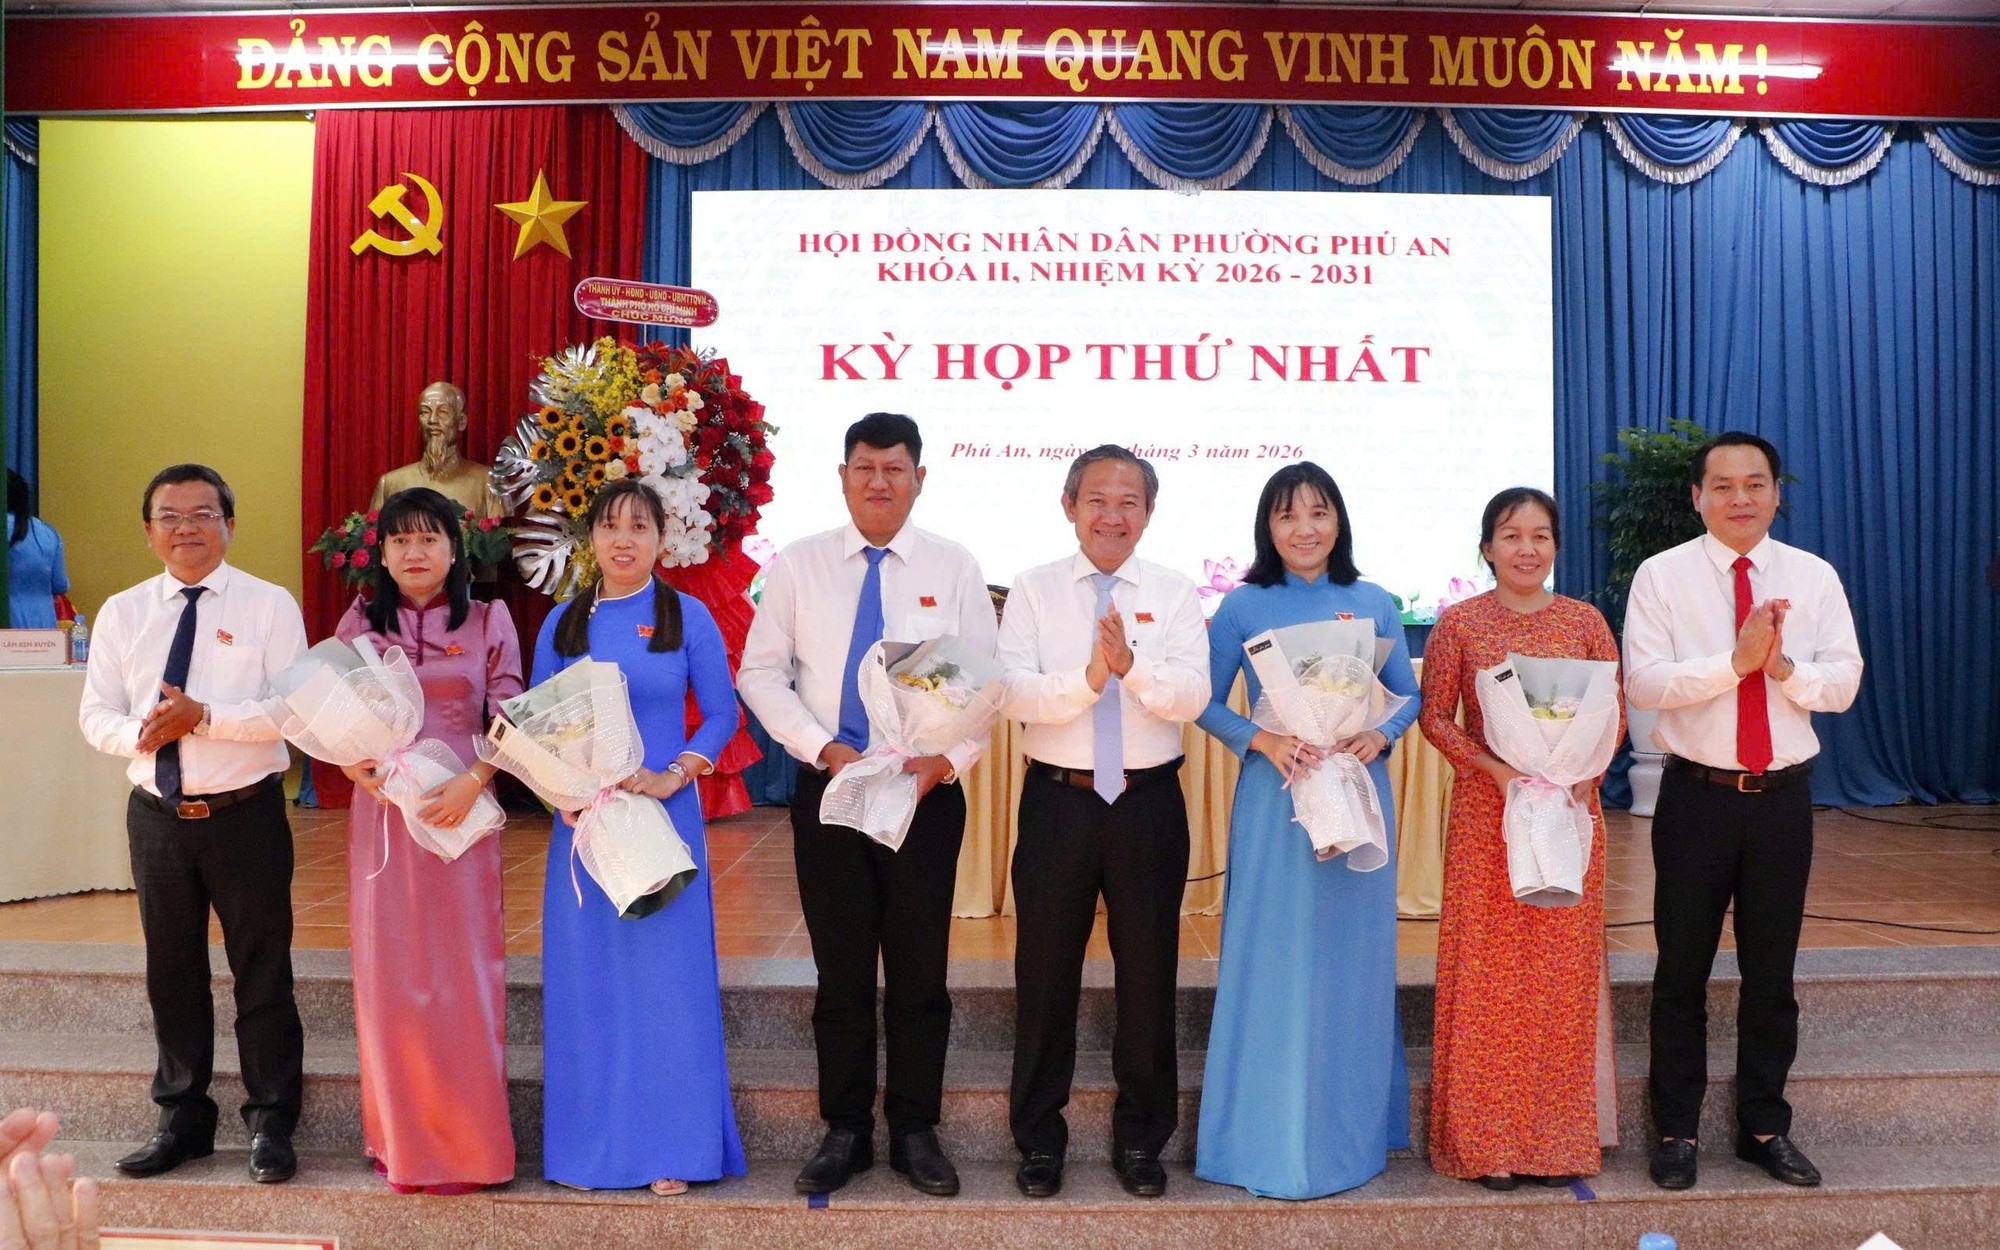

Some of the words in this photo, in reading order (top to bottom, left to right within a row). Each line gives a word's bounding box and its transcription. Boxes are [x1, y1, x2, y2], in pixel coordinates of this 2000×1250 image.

[236, 18, 393, 89] ĐẢNG
[417, 19, 576, 97] CỘNG
[596, 11, 713, 82] SẢN
[730, 14, 873, 92] VIỆT
[892, 28, 1023, 79] NAM
[1044, 28, 1250, 92] QUANG
[1263, 31, 1409, 85] VINH
[1428, 23, 1596, 90] MUÔN
[799, 228, 861, 257] HỘI
[873, 226, 971, 253] ĐỒNG
[980, 227, 1081, 253] NHÂN
[1090, 227, 1162, 253] DÂN
[1172, 228, 1319, 255] PHƯỜNG
[1331, 230, 1397, 256] PHÚ
[1406, 237, 1452, 257] AN
[878, 256, 980, 283] KHÓA
[987, 261, 1020, 287] II,
[1029, 256, 1146, 288] NHIỆM
[1158, 257, 1205, 283] KỲ
[1215, 262, 1282, 283] 2026
[1310, 263, 1374, 285] 2031
[818, 331, 912, 381] KỲ
[933, 343, 1072, 391] HỌP
[1085, 332, 1235, 383] THỨ
[1250, 334, 1431, 383] NHẤT
[950, 442, 991, 458] Phú
[996, 444, 1031, 459] An,
[1187, 445, 1198, 458] 3
[1206, 444, 1250, 458] năm
[1256, 443, 1305, 459] 2026
